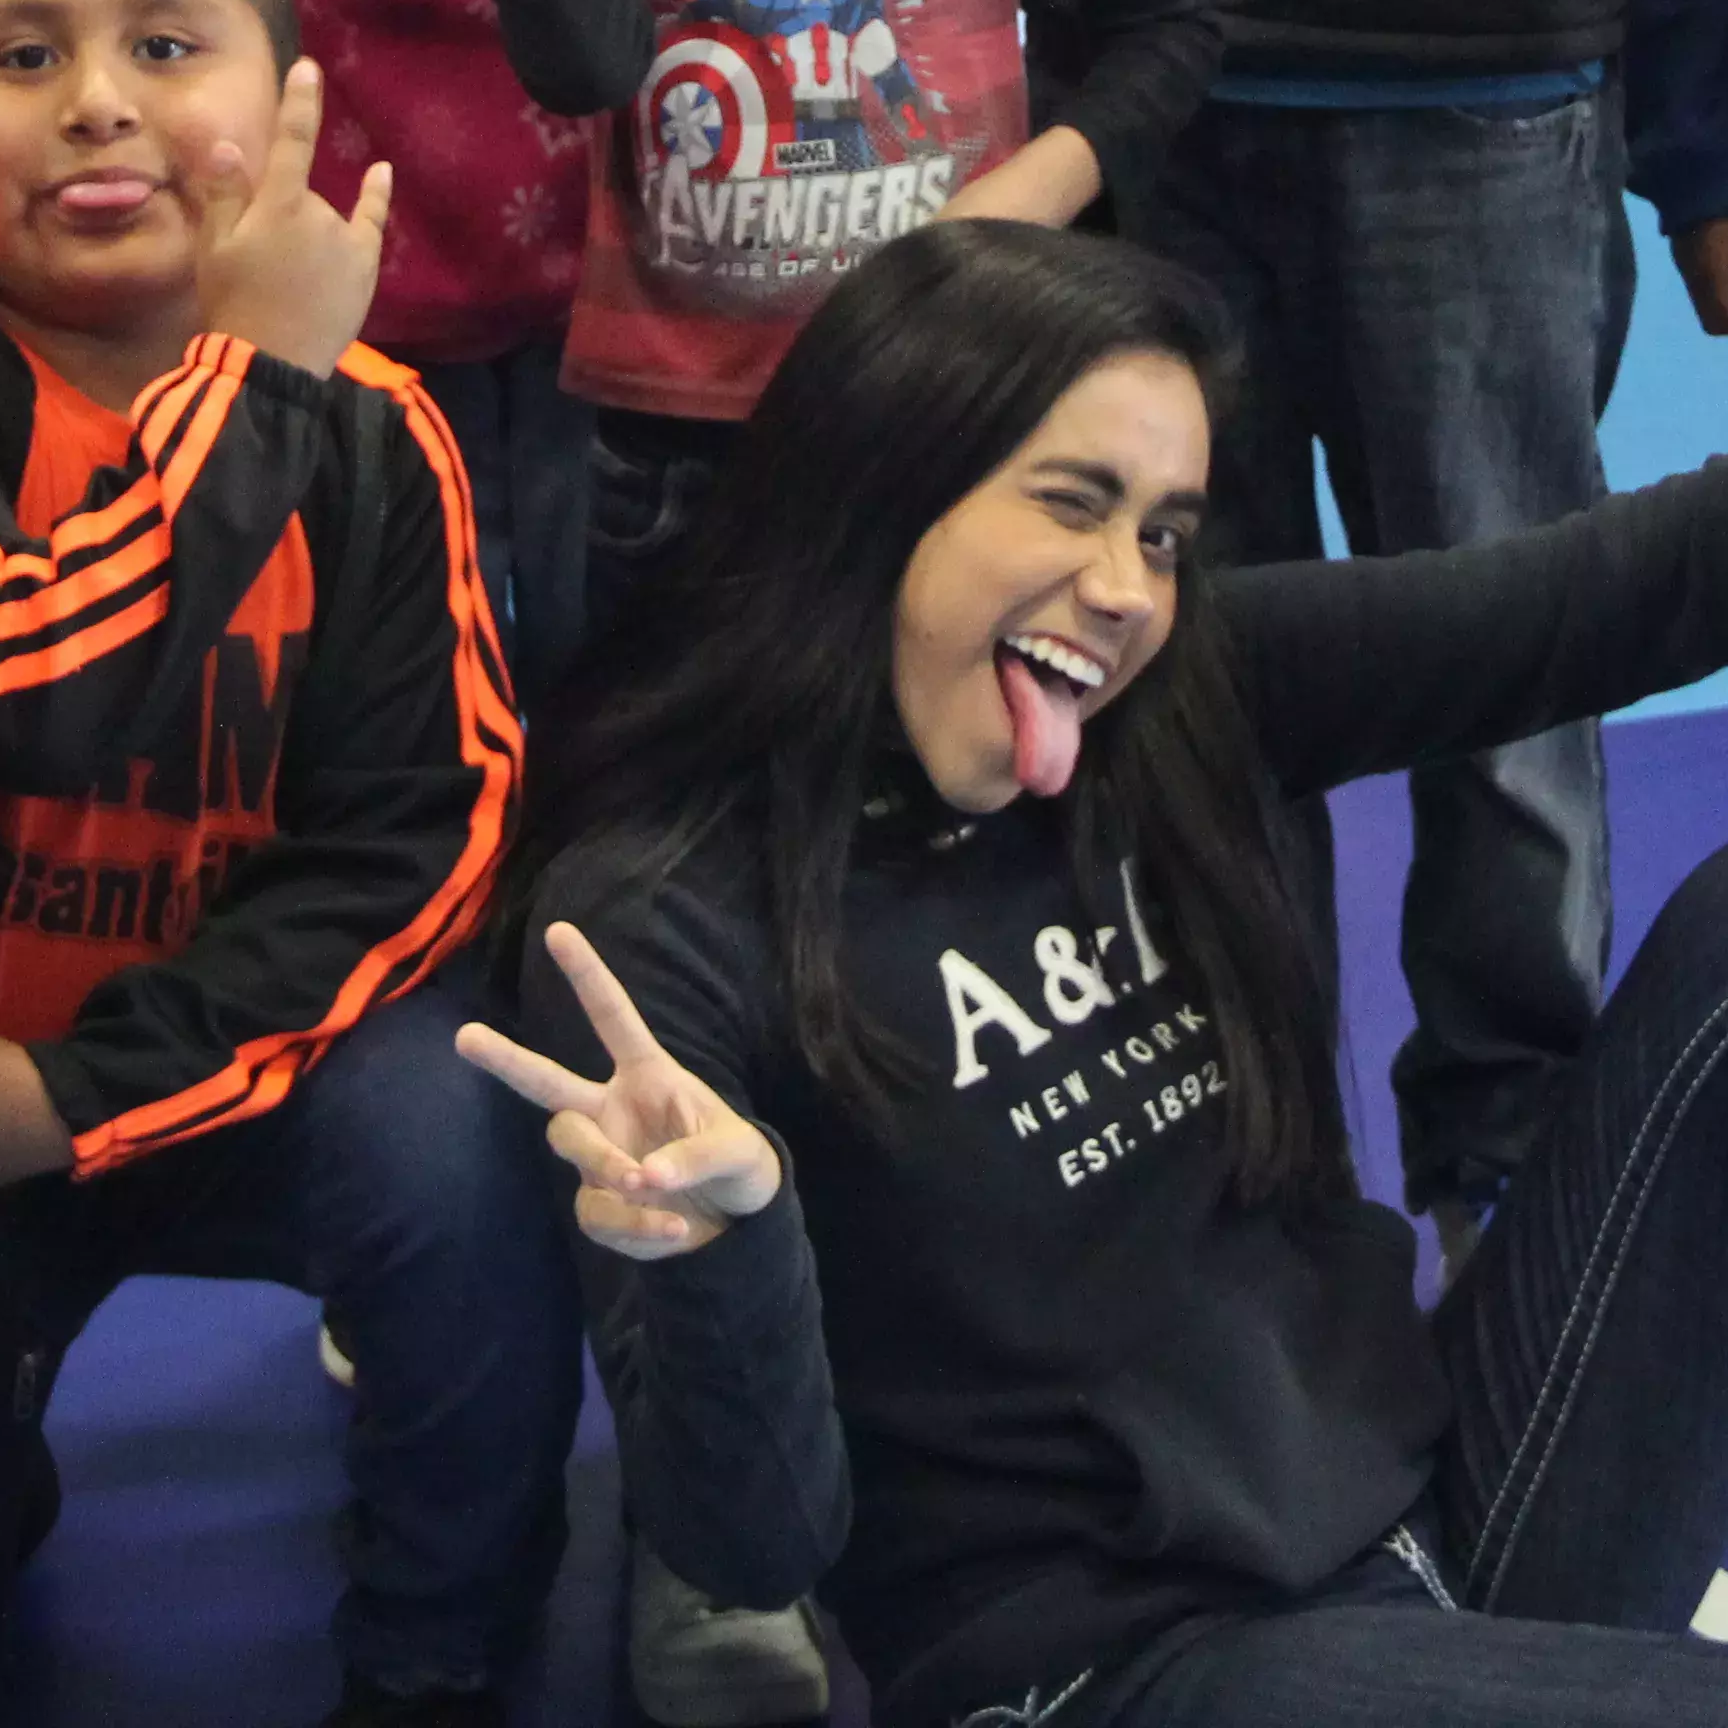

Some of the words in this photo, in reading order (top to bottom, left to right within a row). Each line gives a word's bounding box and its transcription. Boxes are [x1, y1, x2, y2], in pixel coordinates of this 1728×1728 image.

[1010, 1071, 1091, 1139] NEW
[1101, 1003, 1207, 1079] YORK
[1058, 1122, 1137, 1188] EST.
[1143, 1060, 1227, 1134] 1892
